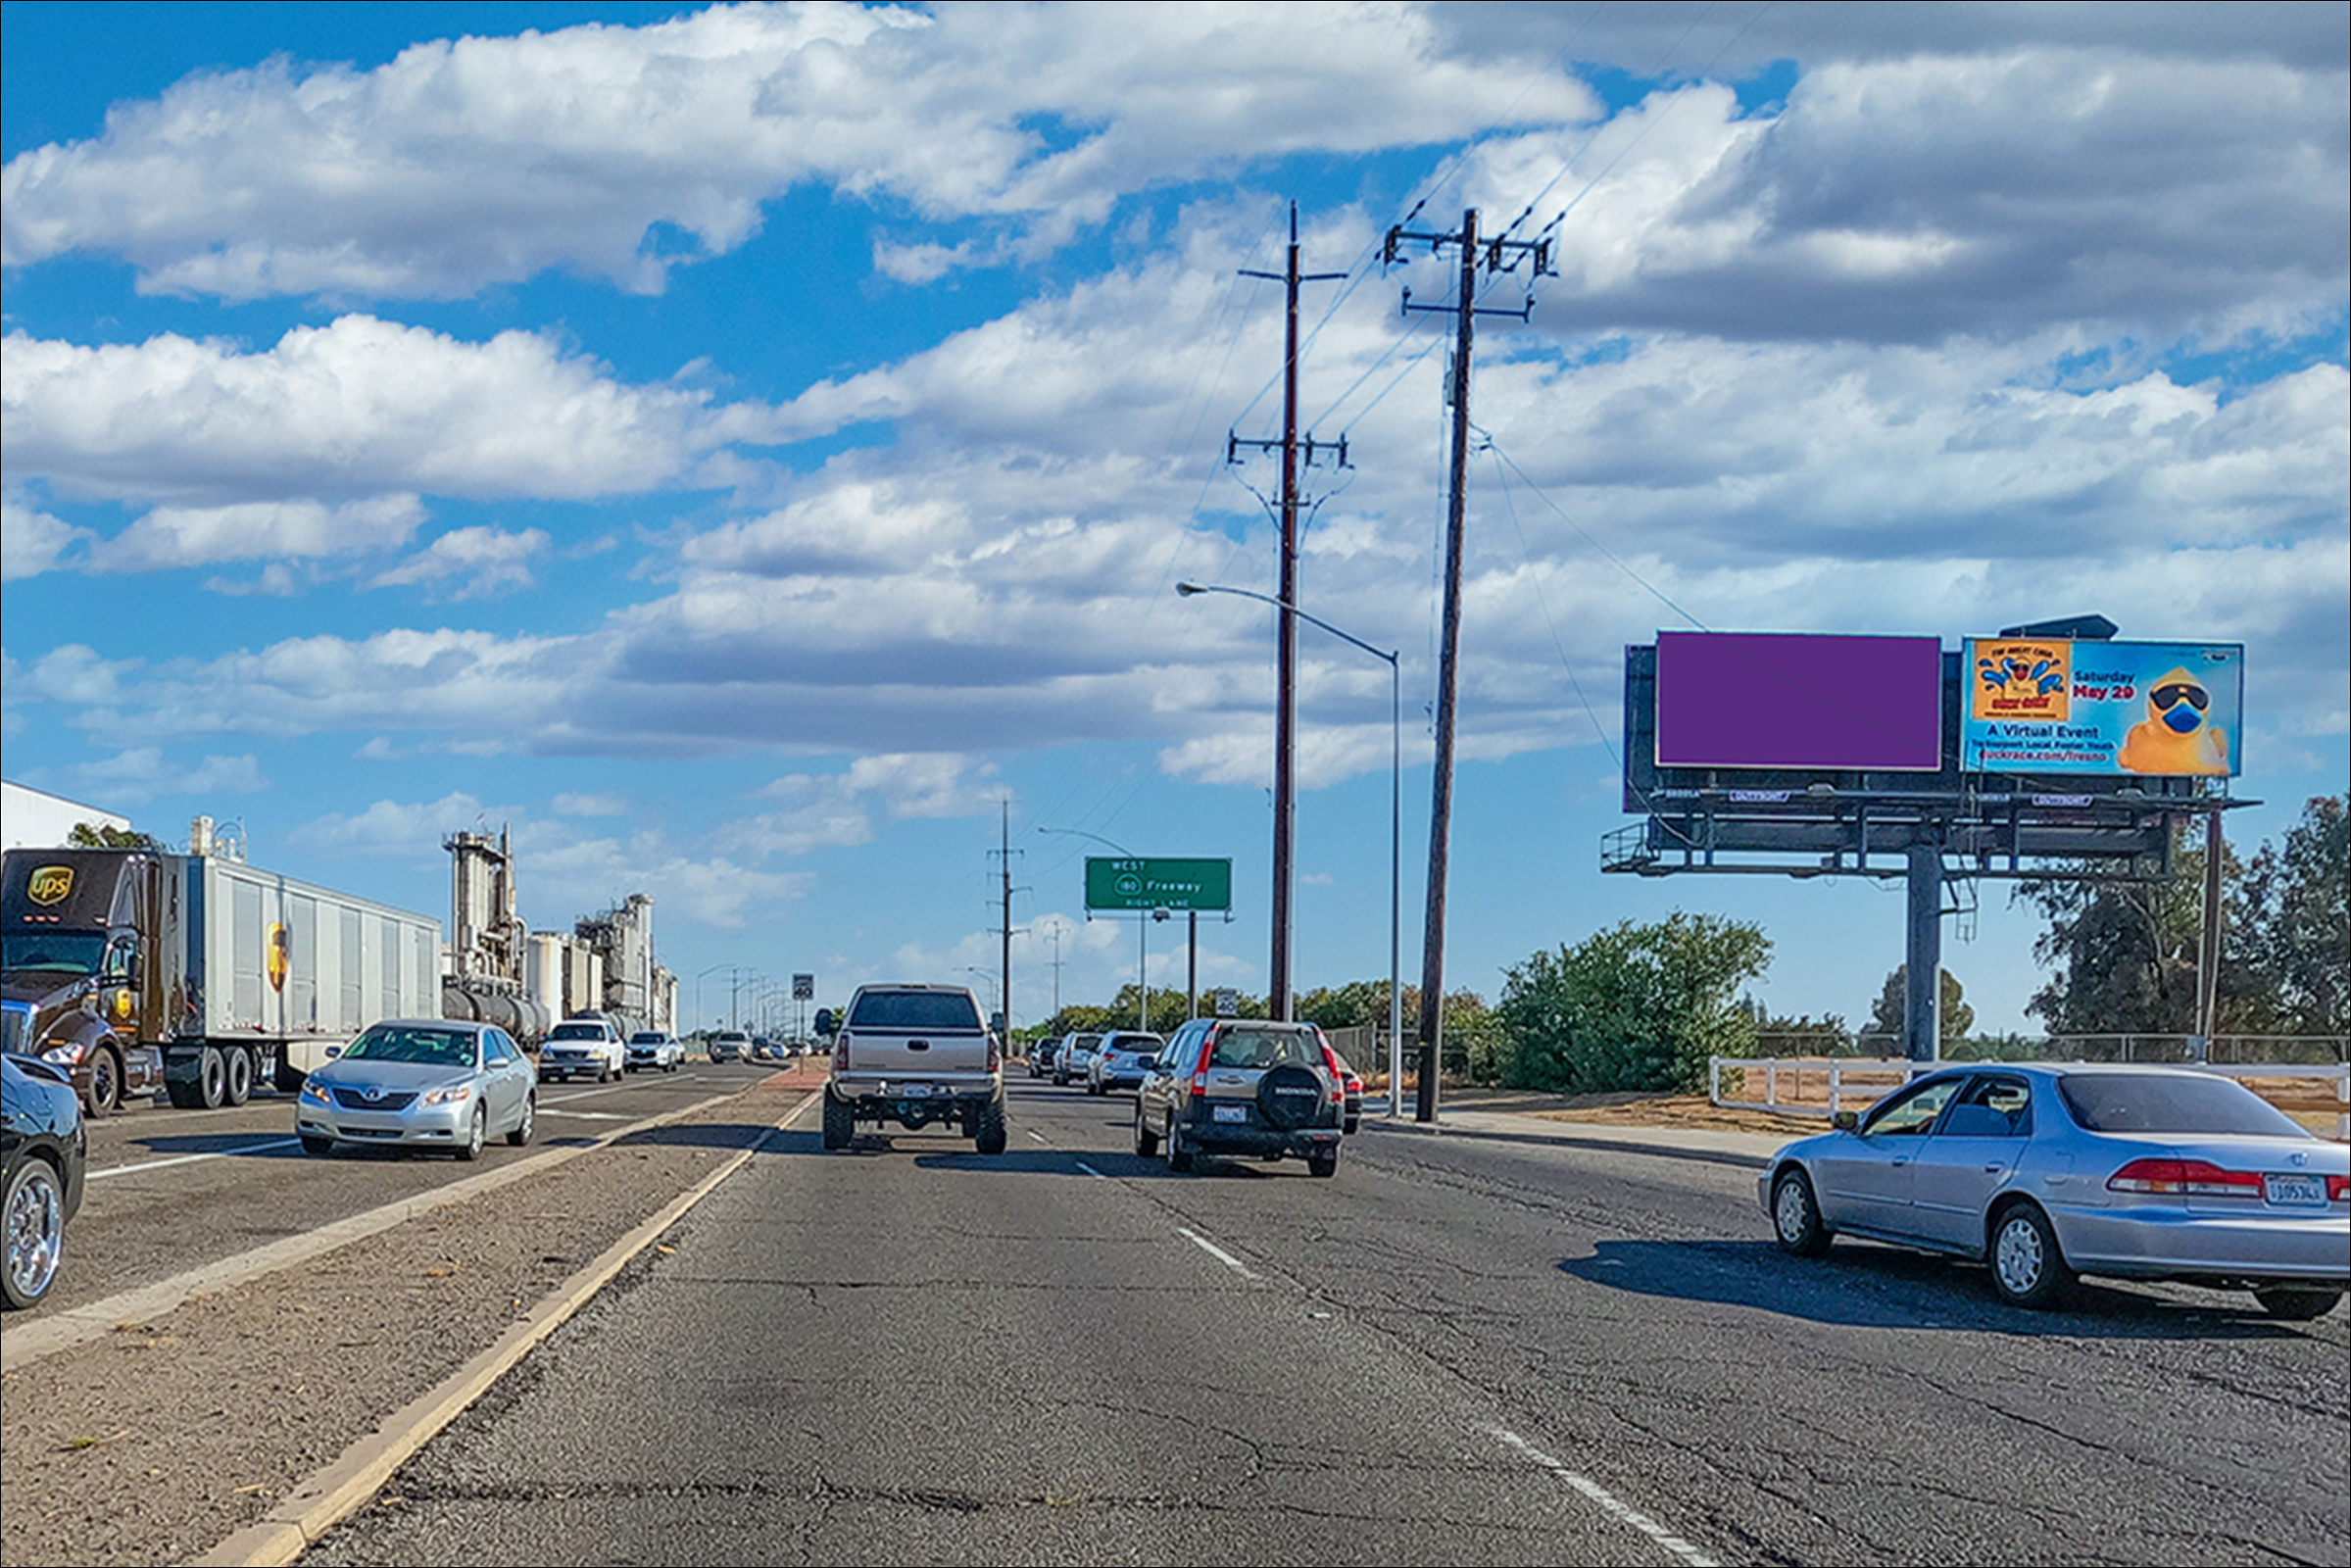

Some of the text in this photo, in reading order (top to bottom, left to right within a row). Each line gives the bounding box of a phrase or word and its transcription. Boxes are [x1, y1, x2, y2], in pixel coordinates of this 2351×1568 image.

[2074, 670, 2135, 685] Saturday
[2073, 684, 2108, 702] May
[1987, 724, 2099, 739] A Virtual Event
[1111, 860, 1146, 871] WEST
[1147, 880, 1202, 893] Freeway
[1275, 1087, 1317, 1097] HONDA
